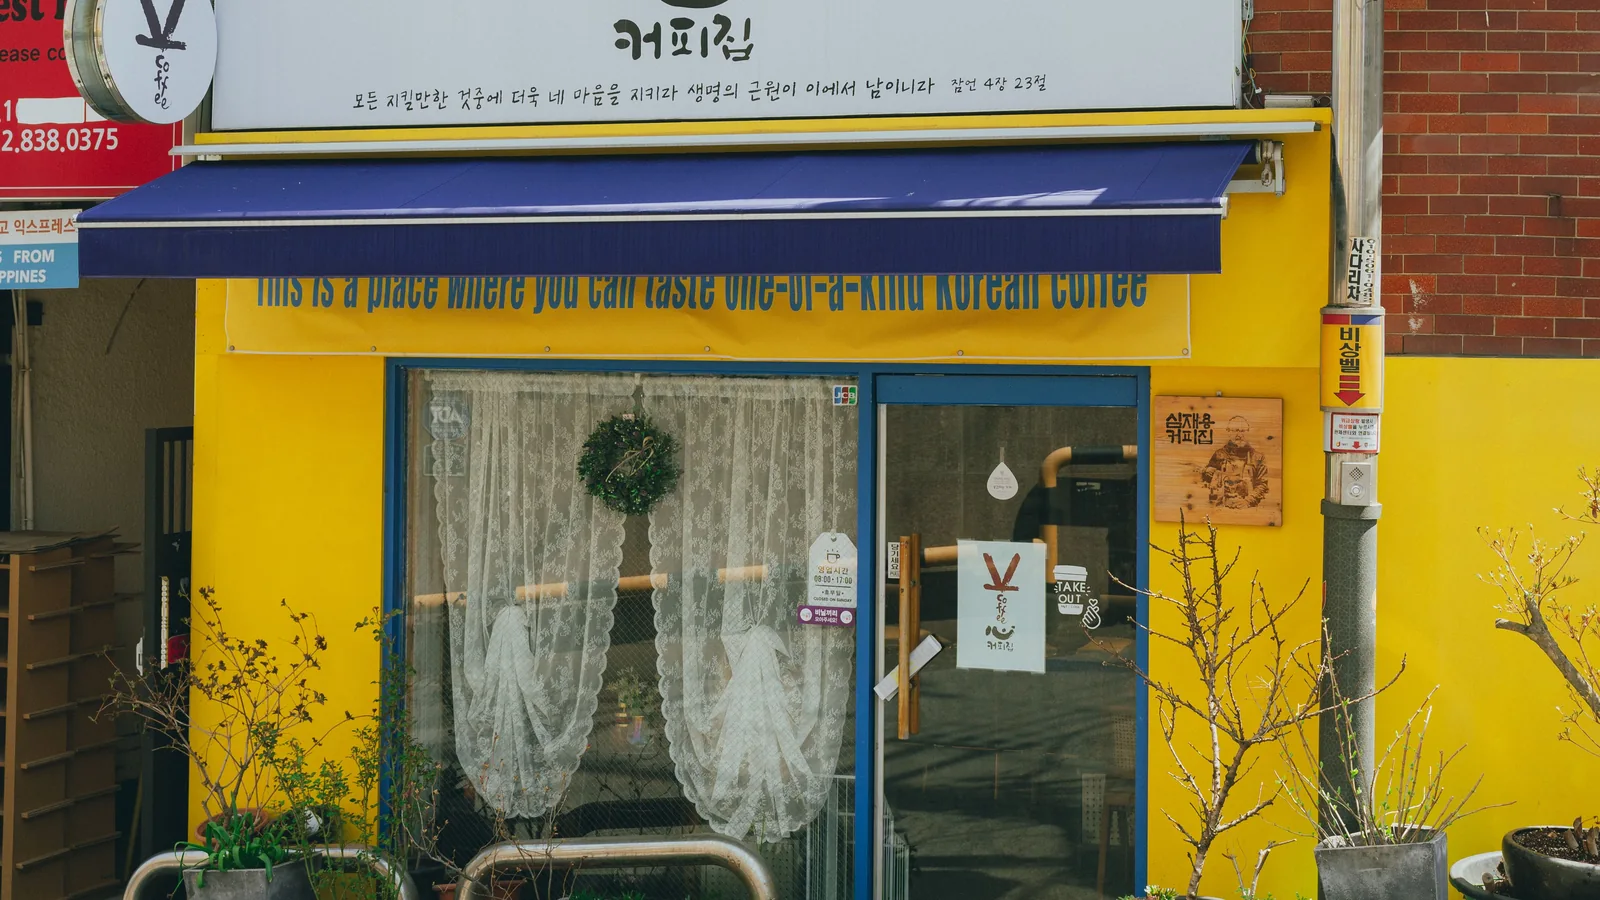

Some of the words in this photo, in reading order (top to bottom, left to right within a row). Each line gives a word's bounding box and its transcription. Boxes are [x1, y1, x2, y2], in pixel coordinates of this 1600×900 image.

[613, 13, 754, 61] 커피집
[353, 90, 378, 110] 모든
[387, 88, 448, 111] 지킬만한
[458, 87, 503, 110] 것중에
[512, 86, 540, 107] 더욱
[549, 88, 564, 105] 네
[573, 83, 621, 106] 마음을
[630, 84, 679, 102] 지키라
[687, 82, 739, 103] 생명의
[747, 80, 797, 101] 근원이
[805, 78, 856, 97] 이에서
[866, 77, 935, 99] 남이니라
[951, 77, 977, 93] 잠언
[984, 76, 1008, 92] 4장
[1014, 74, 1047, 92] 23절
[14, 218, 76, 235] 익스프레스
[13, 249, 55, 263] FROM
[1347, 238, 1364, 302] 사다리차
[344, 277, 359, 309] a
[533, 277, 579, 314] you
[588, 276, 637, 310] can
[1339, 327, 1361, 374] 비상벨
[1166, 429, 1213, 445] 커피집
[818, 566, 848, 575] 영업시간
[1057, 582, 1086, 593] TAKE
[1058, 594, 1081, 604] OUT
